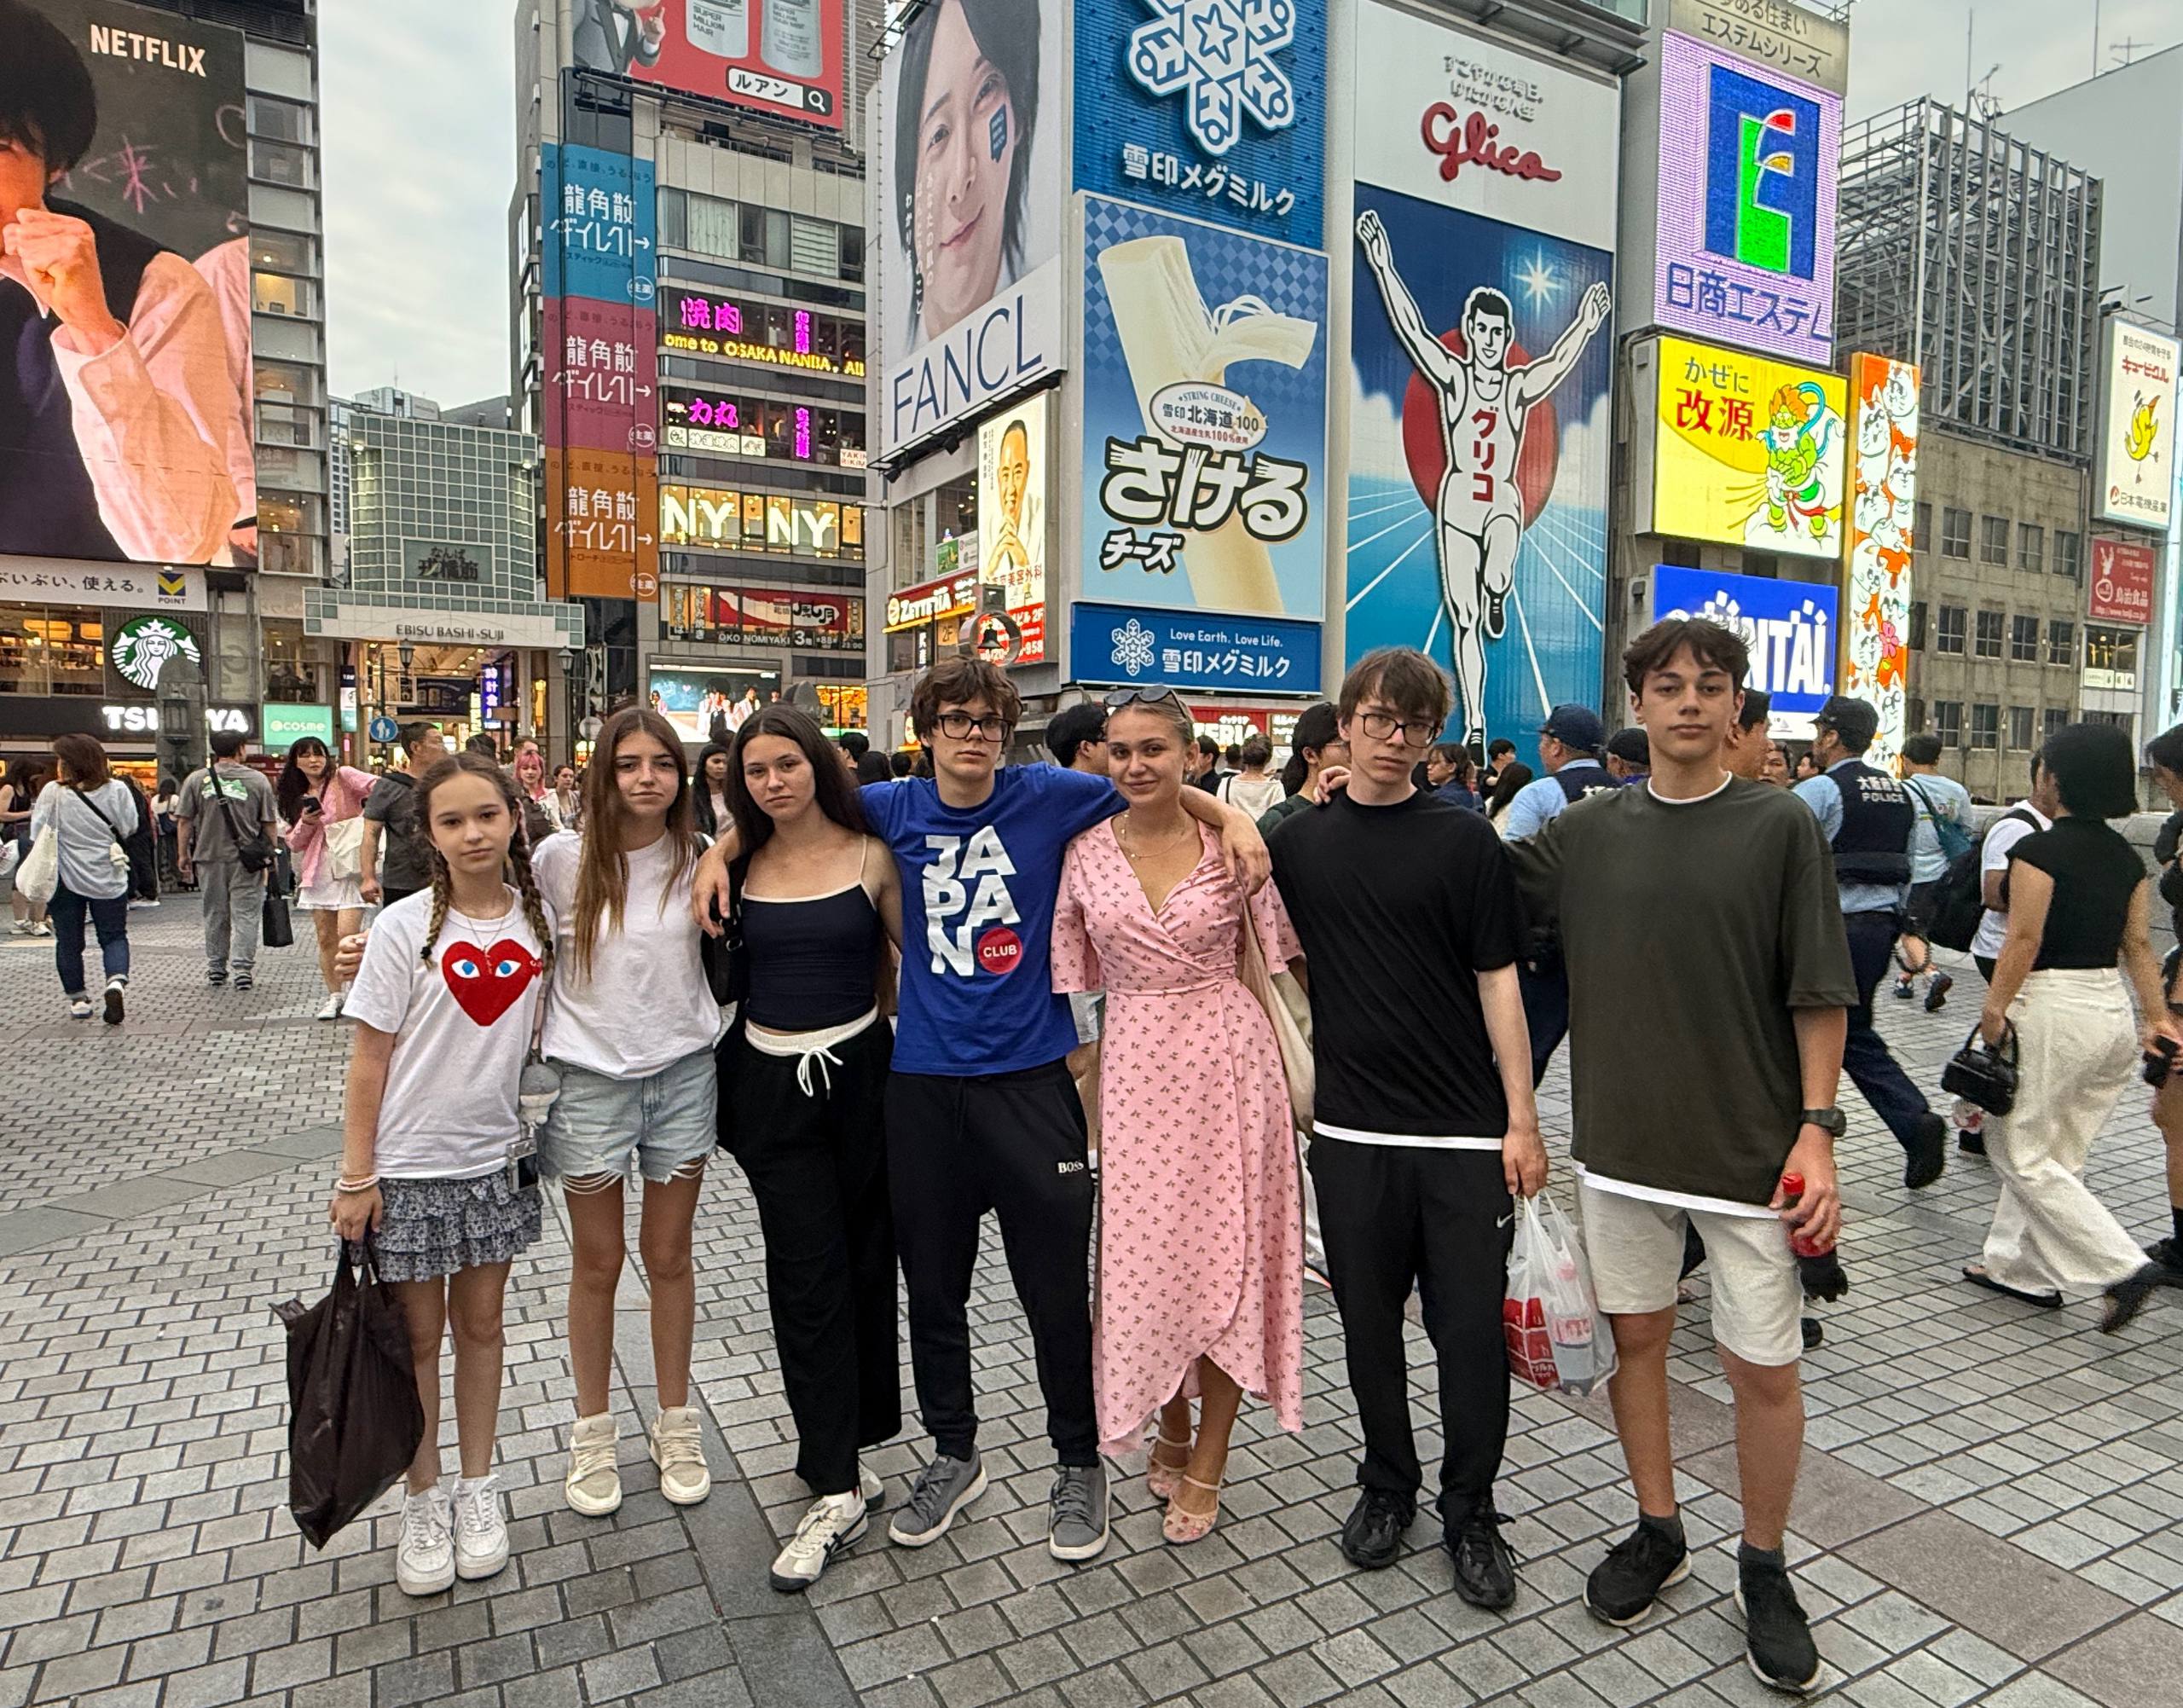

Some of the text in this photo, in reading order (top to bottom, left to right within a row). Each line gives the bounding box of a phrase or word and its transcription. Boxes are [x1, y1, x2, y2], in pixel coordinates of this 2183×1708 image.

[90, 24, 206, 78] NETFLIX
[1702, 12, 1821, 78] エステムシリーズ
[736, 74, 788, 97] ルアン
[1422, 101, 1562, 182] Glico
[1123, 142, 1295, 215] 雪印メグミルク
[565, 183, 637, 225] 龍角散
[680, 298, 744, 335] 焼肉
[1666, 262, 1833, 343] 日商エステム
[566, 335, 639, 373] 龍角散
[701, 337, 718, 354] to
[724, 340, 778, 363] OSAKA
[894, 294, 1042, 443] FANCL
[1685, 356, 1750, 394] かぜに
[688, 397, 739, 428] 力丸
[1184, 391, 1237, 411] STRING CHEESE
[1676, 387, 1755, 443] 改源
[1471, 405, 1499, 503] グリコ
[569, 486, 640, 522] 龍角散
[1101, 437, 1307, 541] さける
[663, 495, 835, 548] NY NY
[1102, 529, 1184, 573] チーズ
[397, 624, 434, 637] EBISU
[1170, 628, 1283, 648] Love Earth. Love Life.
[1162, 648, 1290, 679] 雪印メグミルク
[101, 705, 249, 732] TSYA
[1862, 792, 1906, 804] POLICE
[983, 944, 1017, 958] CLUB
